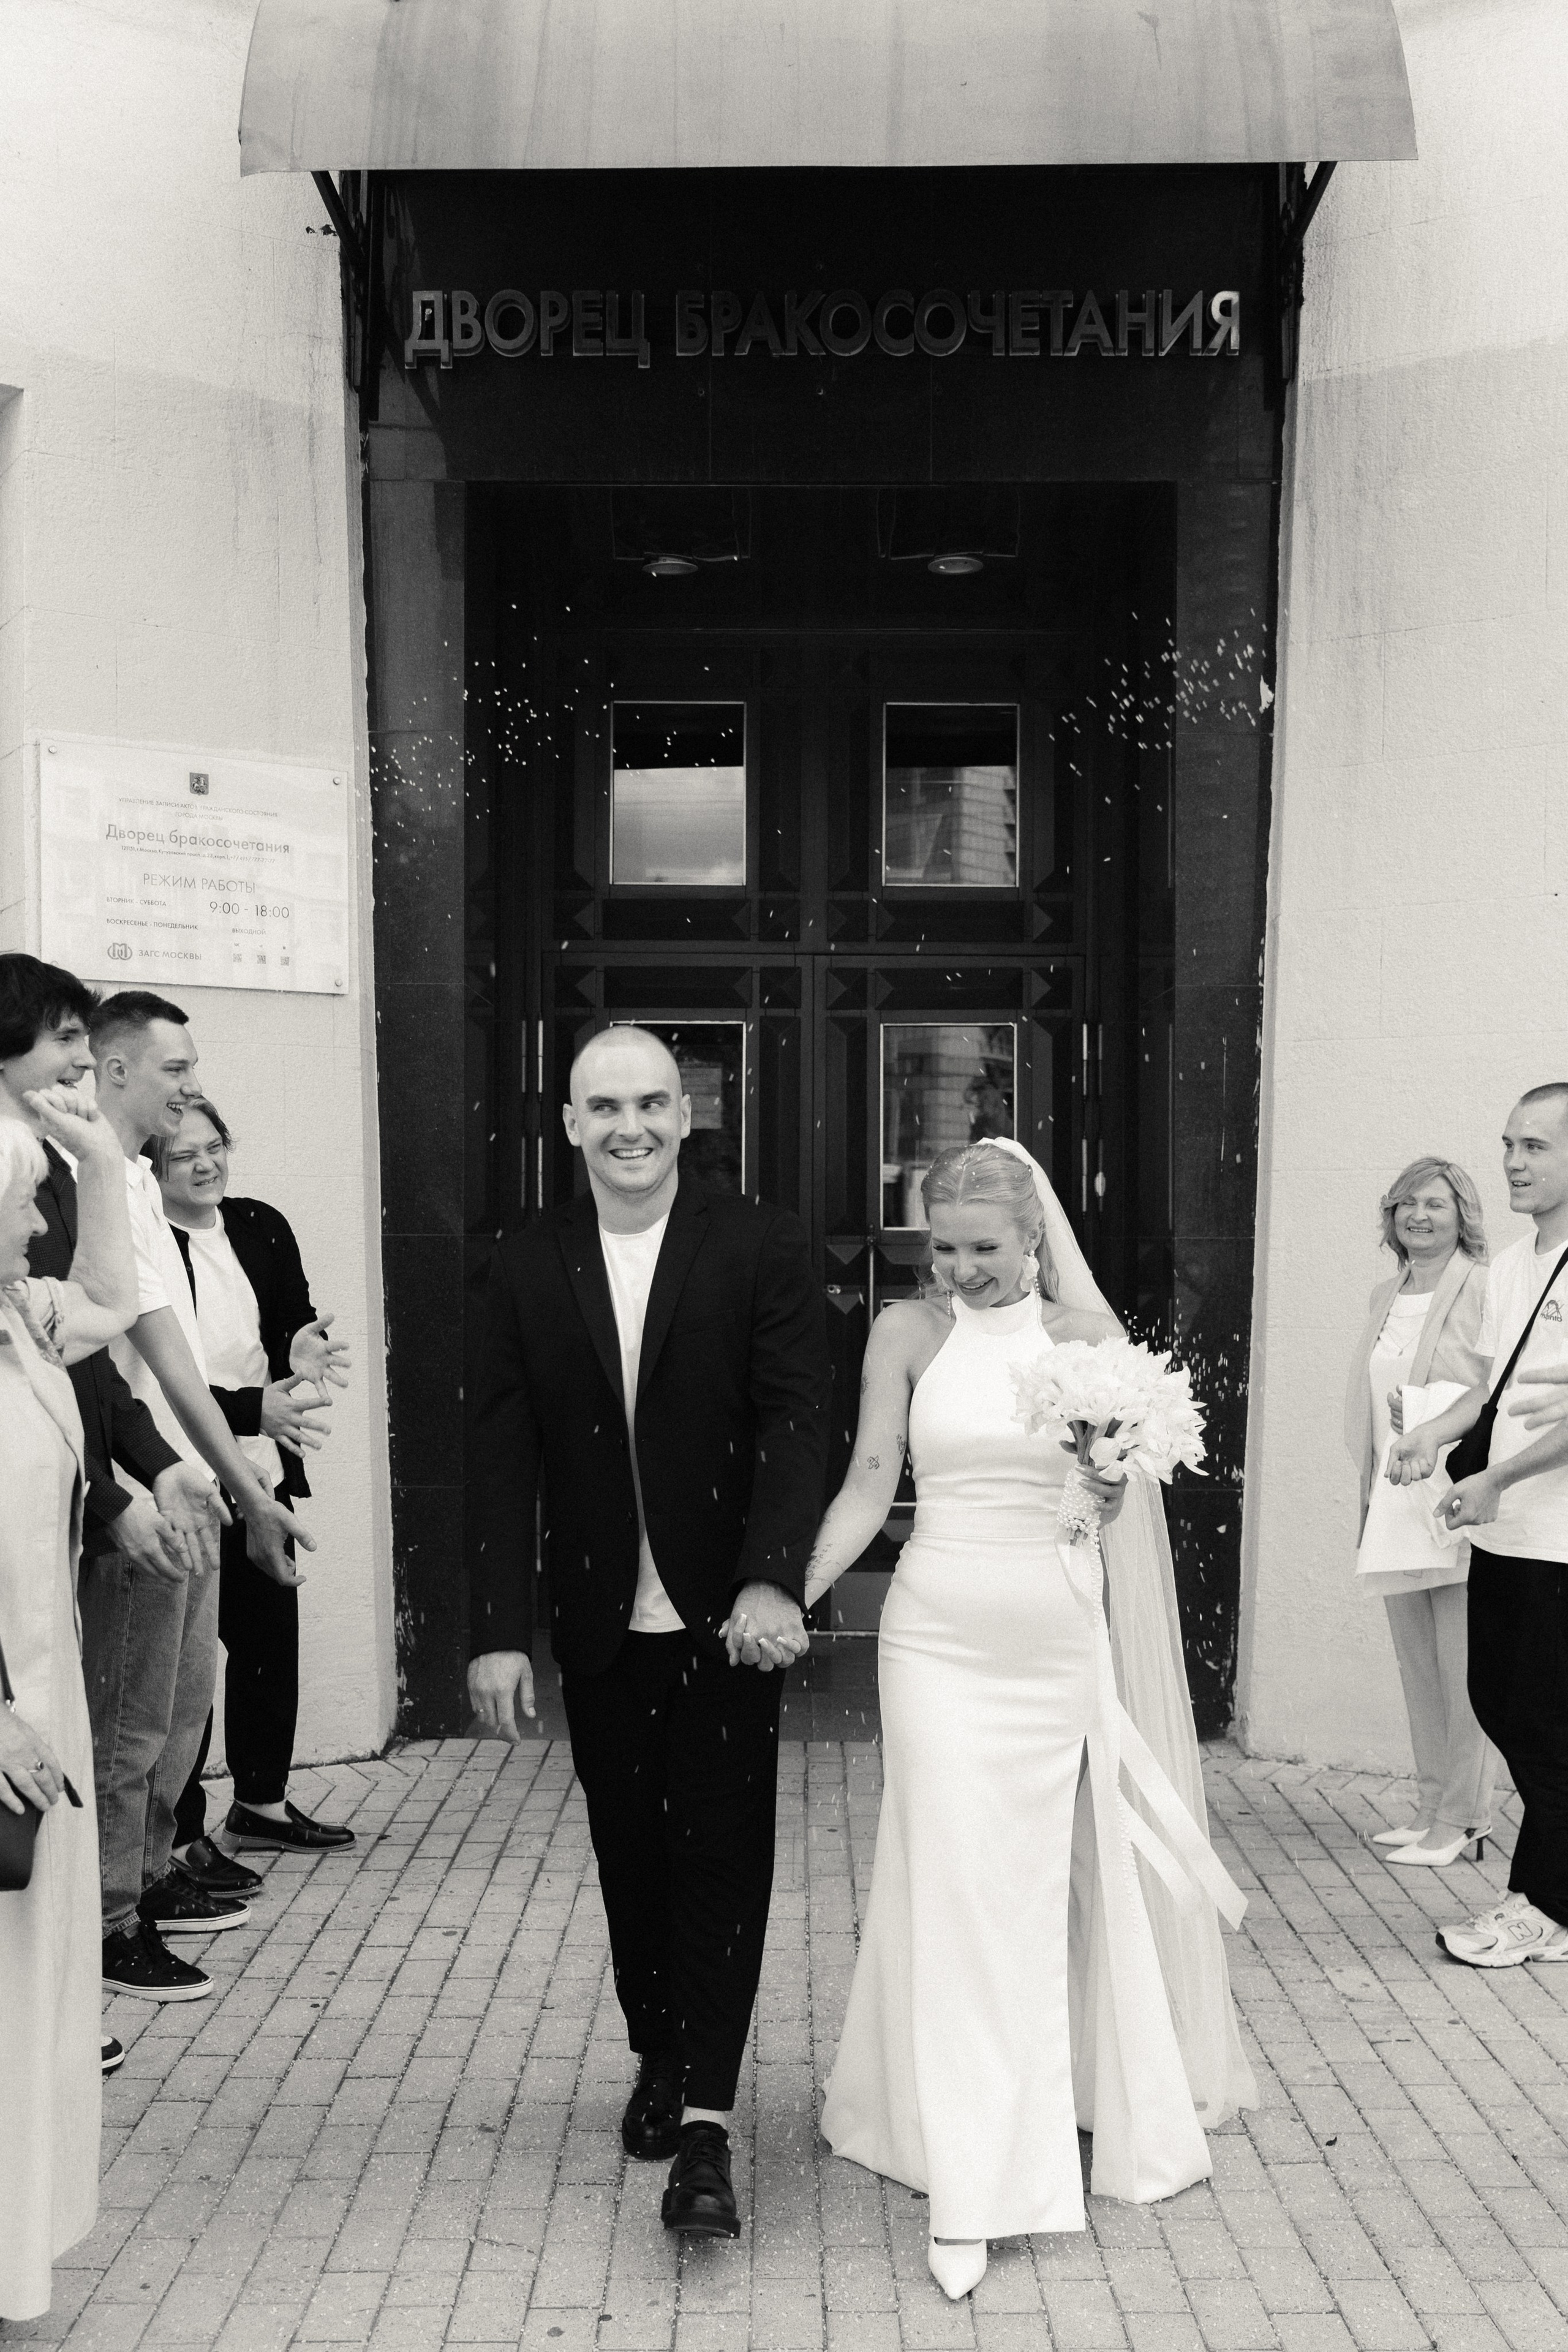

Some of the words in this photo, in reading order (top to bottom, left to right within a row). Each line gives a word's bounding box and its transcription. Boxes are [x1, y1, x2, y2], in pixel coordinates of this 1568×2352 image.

[404, 289, 650, 369] ДВОРЕЦ
[676, 288, 1240, 357] БРАКОСОЧЕТАНИЯ
[118, 797, 154, 805] УПРАВЛЕНИЕ
[244, 809, 278, 818] СОСТОЯНИЯ
[106, 824, 164, 845] Дворец
[169, 829, 290, 854] бракосочетания
[143, 873, 197, 889] РЕЖИМ
[202, 878, 255, 894] РАБОТЫ
[209, 901, 239, 914] 9:00
[255, 905, 290, 918] 18:00
[162, 951, 202, 960] МОСКВЫ
